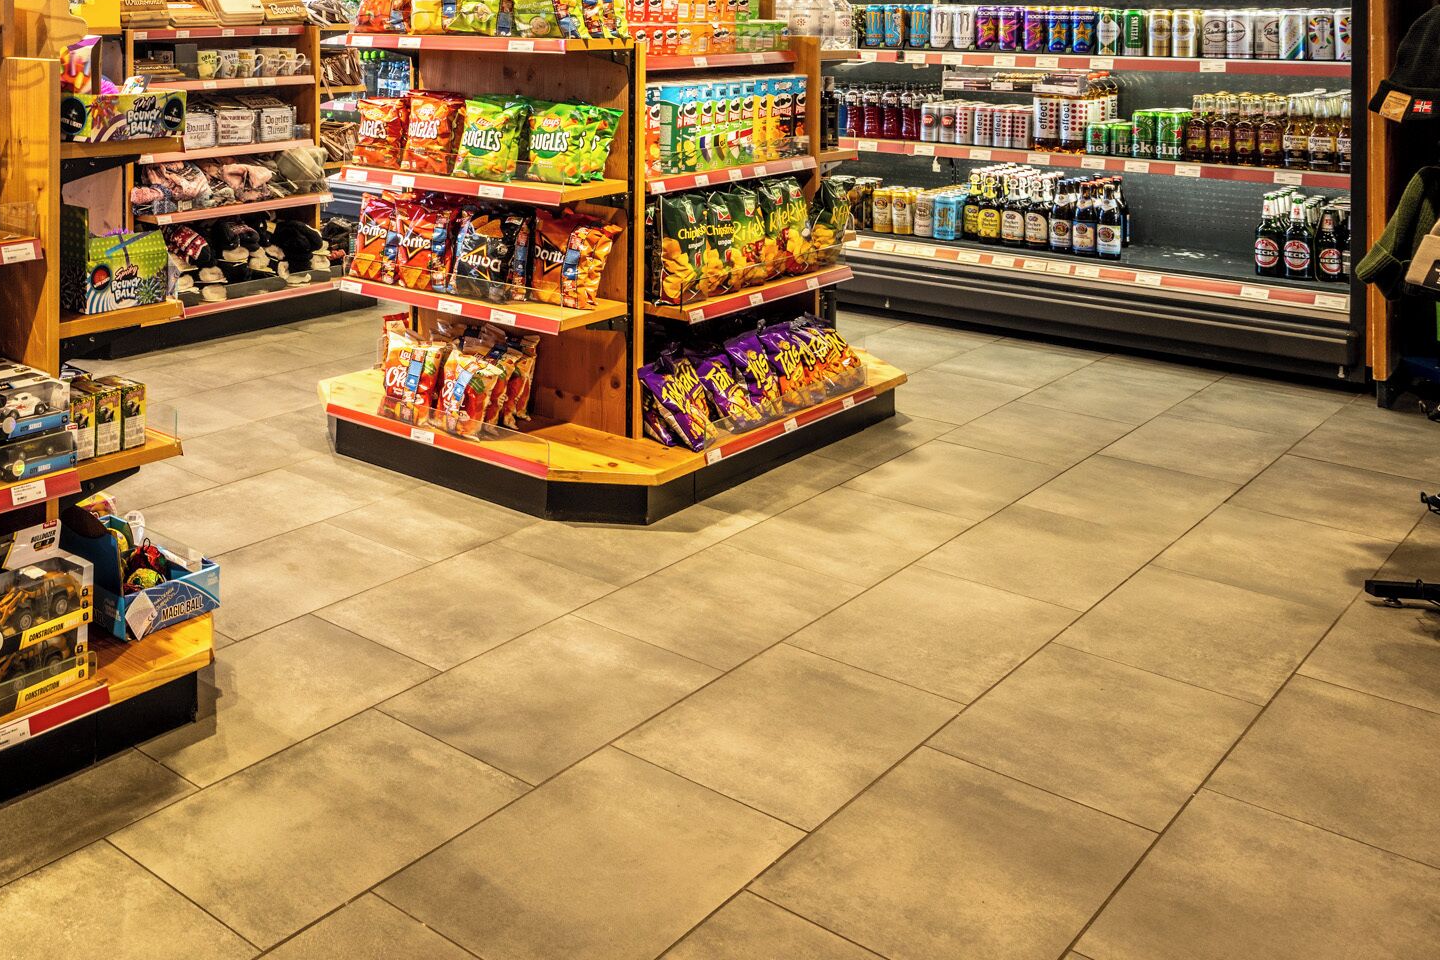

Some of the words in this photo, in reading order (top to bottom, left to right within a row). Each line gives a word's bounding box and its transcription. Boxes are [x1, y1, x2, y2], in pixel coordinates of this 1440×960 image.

[1130, 16, 1139, 41] VELTINS
[127, 109, 162, 124] BOUNCY
[994, 114, 1002, 137] effect
[1040, 102, 1048, 130] effect
[130, 122, 155, 136] BALL
[461, 130, 503, 152] BUGLES
[111, 276, 140, 291] BOUNCY
[114, 288, 139, 301] BALL
[30, 529, 57, 544] BULLDOZER
[161, 601, 186, 622] MAGIC
[186, 594, 204, 613] BALL
[28, 622, 64, 643] CONSTRUCTION
[24, 680, 60, 702] CONSTRUCTION
